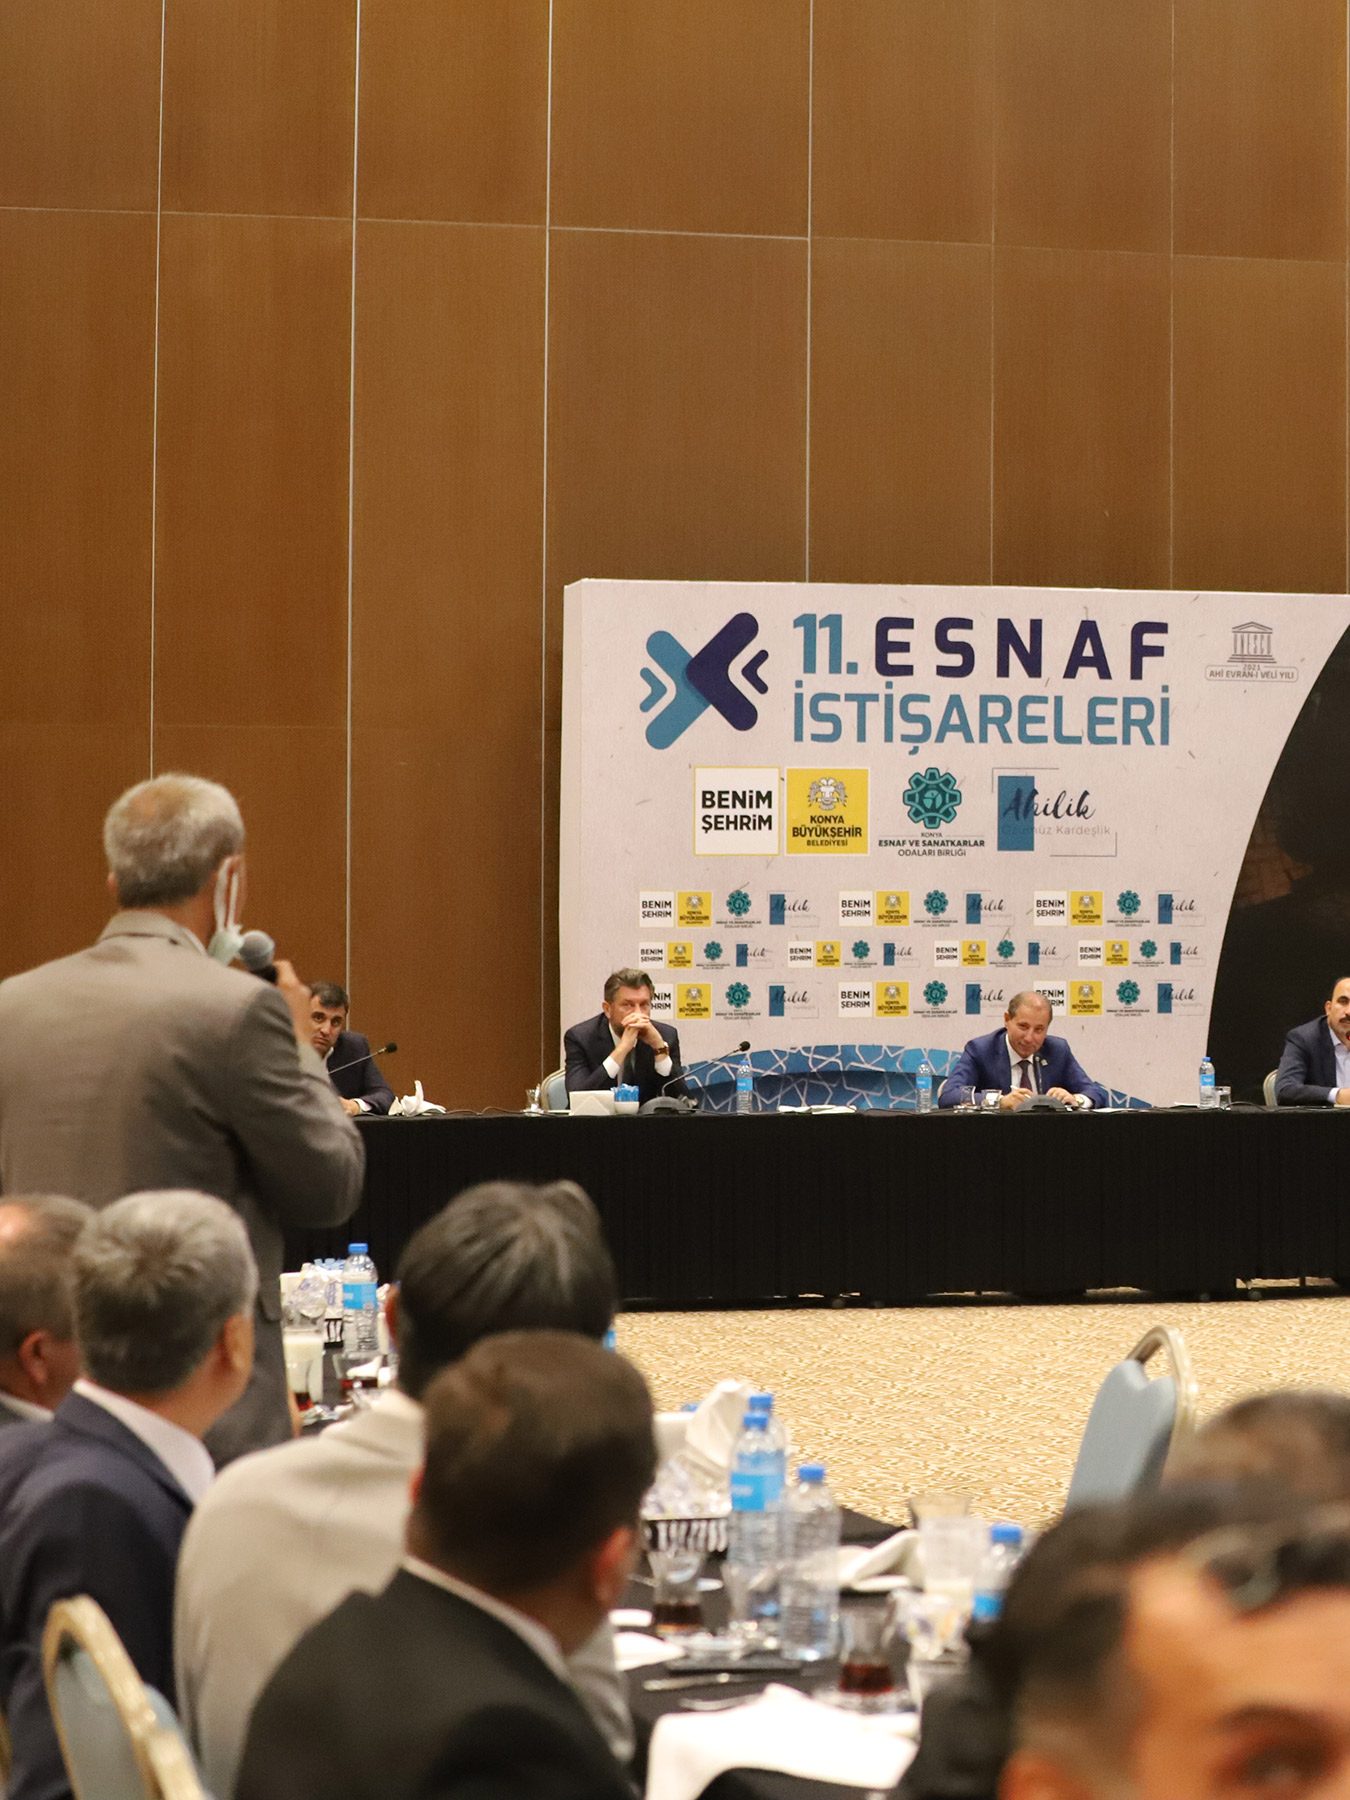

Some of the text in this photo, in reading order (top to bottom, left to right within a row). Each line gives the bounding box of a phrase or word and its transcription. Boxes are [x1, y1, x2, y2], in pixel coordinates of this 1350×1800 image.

[793, 613, 1169, 680] 11. ESNAF
[793, 680, 1170, 755] İSTİŞARELERİ
[810, 815, 844, 824] KONYA
[792, 824, 862, 839] BÜYÜKŞEHİR
[898, 849, 935, 857] ODALARI
